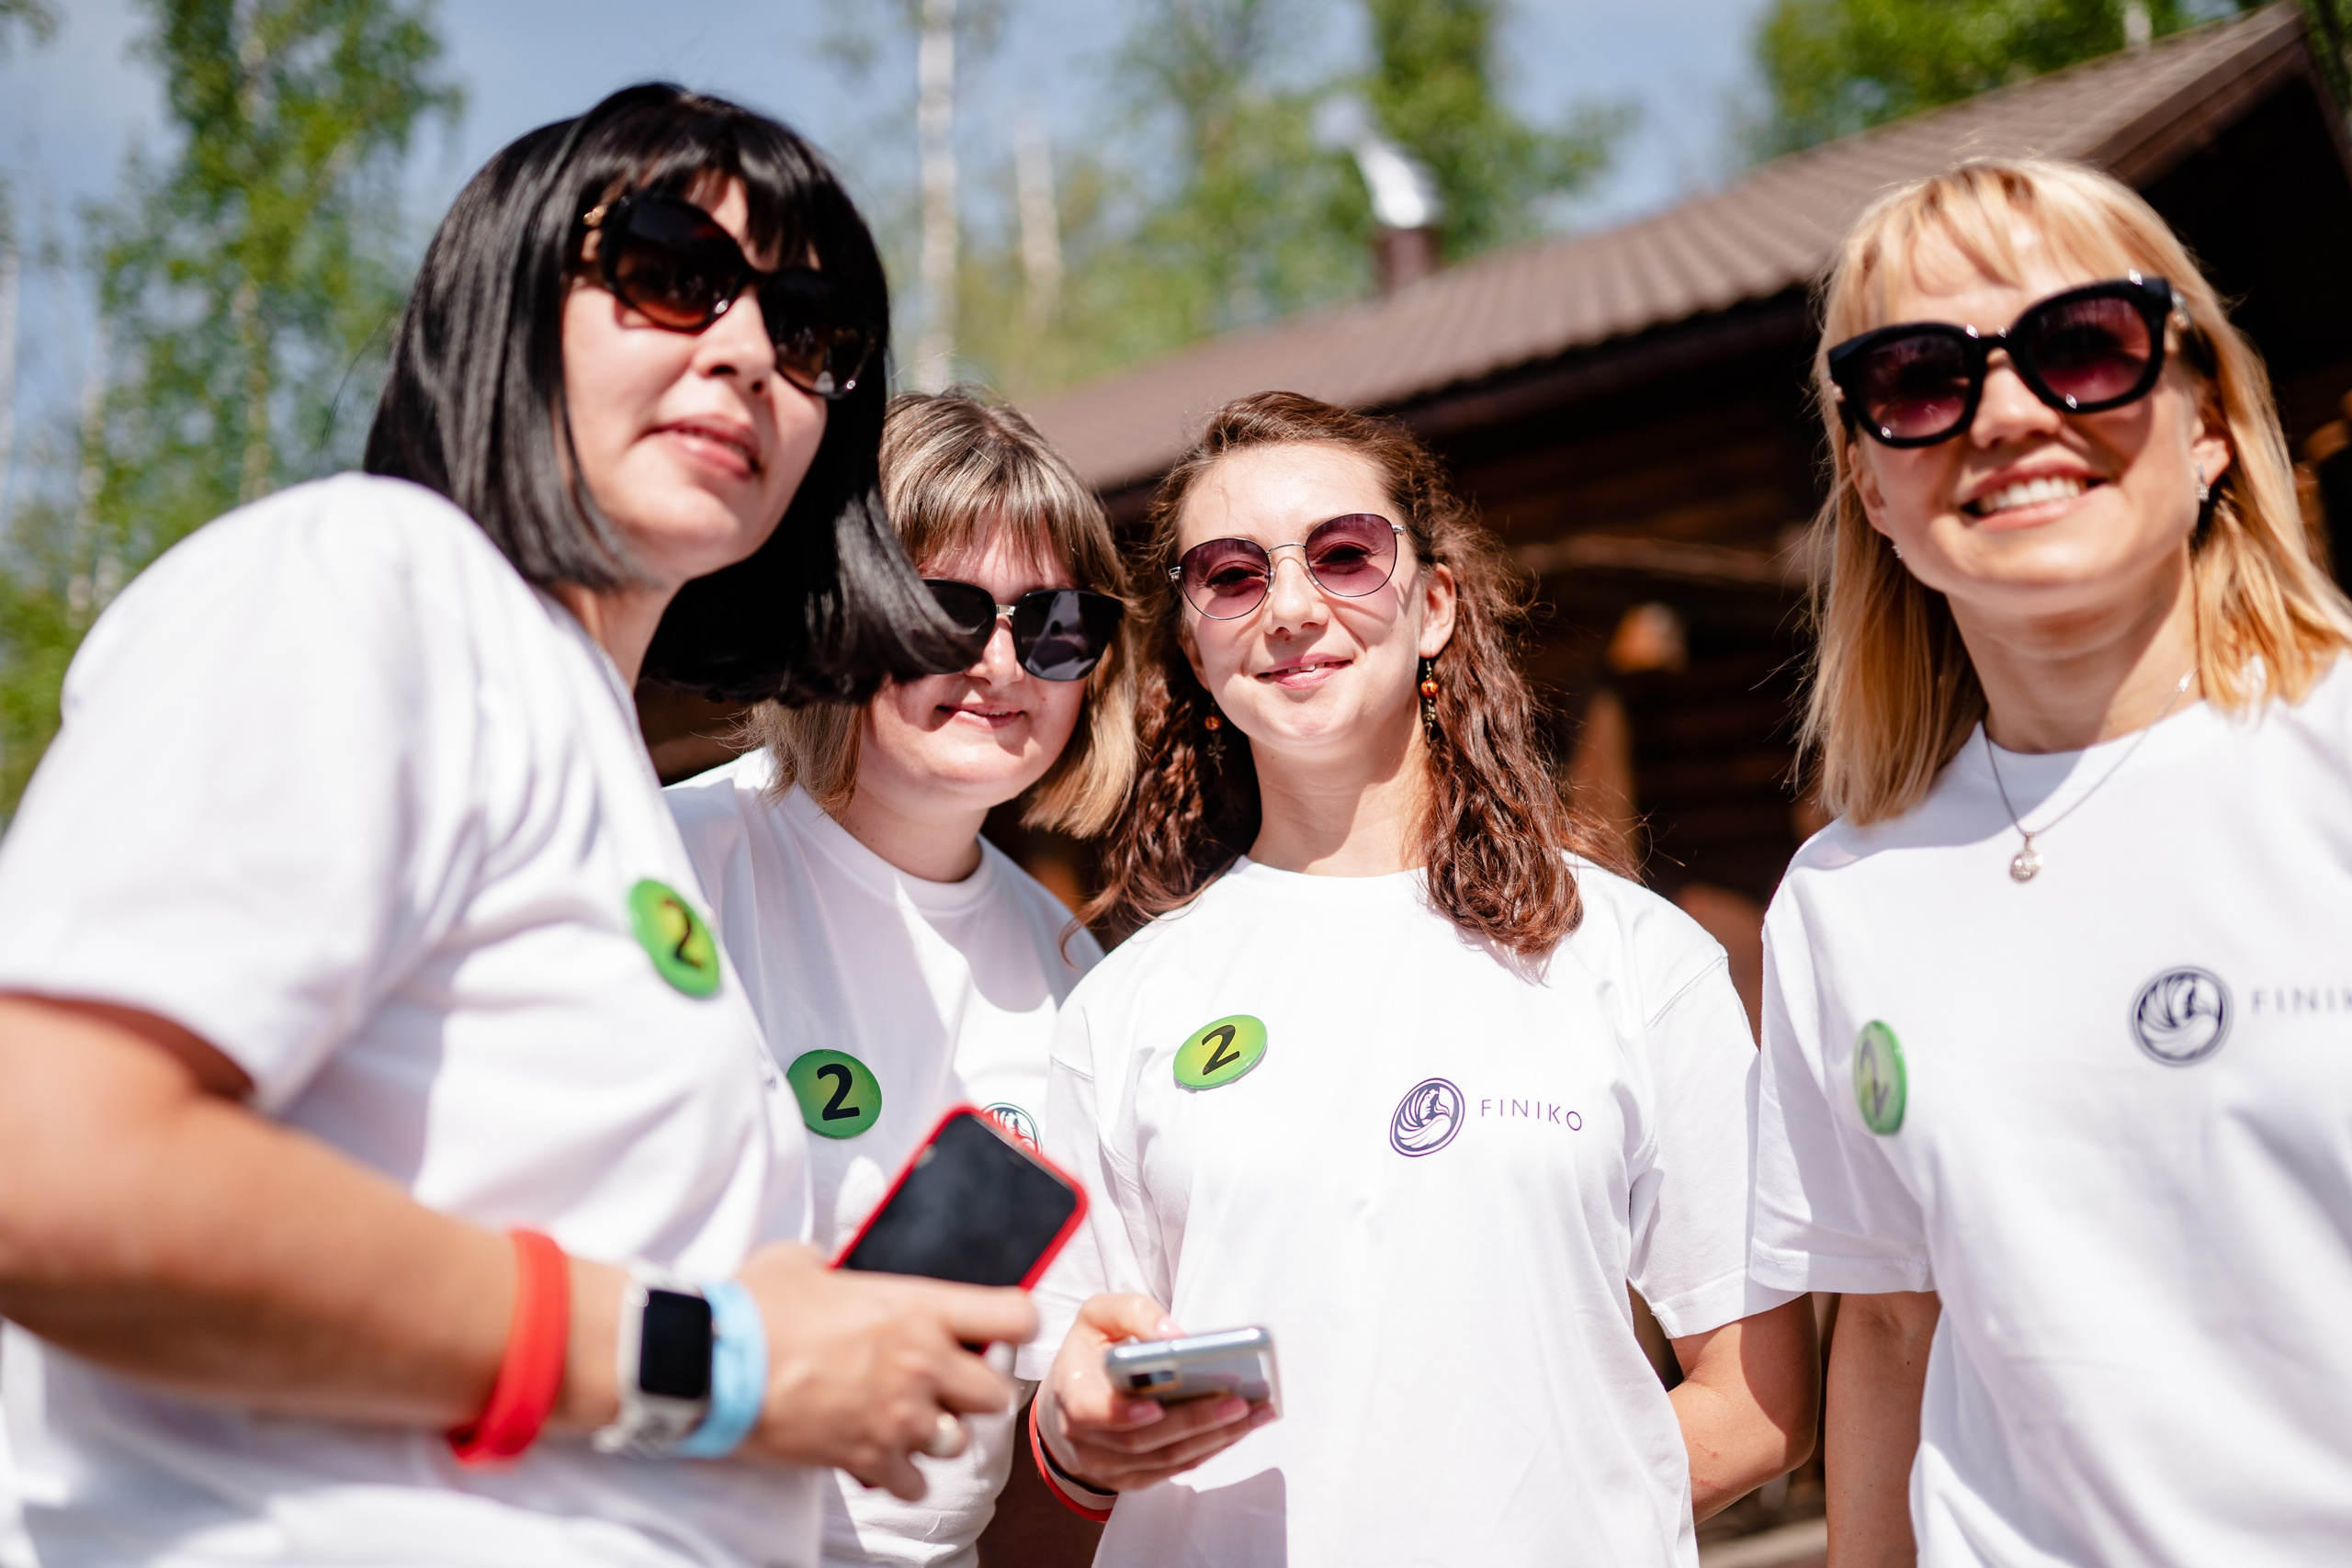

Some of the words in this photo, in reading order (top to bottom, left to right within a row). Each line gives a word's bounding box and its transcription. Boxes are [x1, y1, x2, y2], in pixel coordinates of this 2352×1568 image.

[662, 897, 704, 970] 2
[1201, 1024, 1240, 1076] 2
[816, 1063, 861, 1122] 2
[1481, 1099, 1583, 1132] FINIKO
